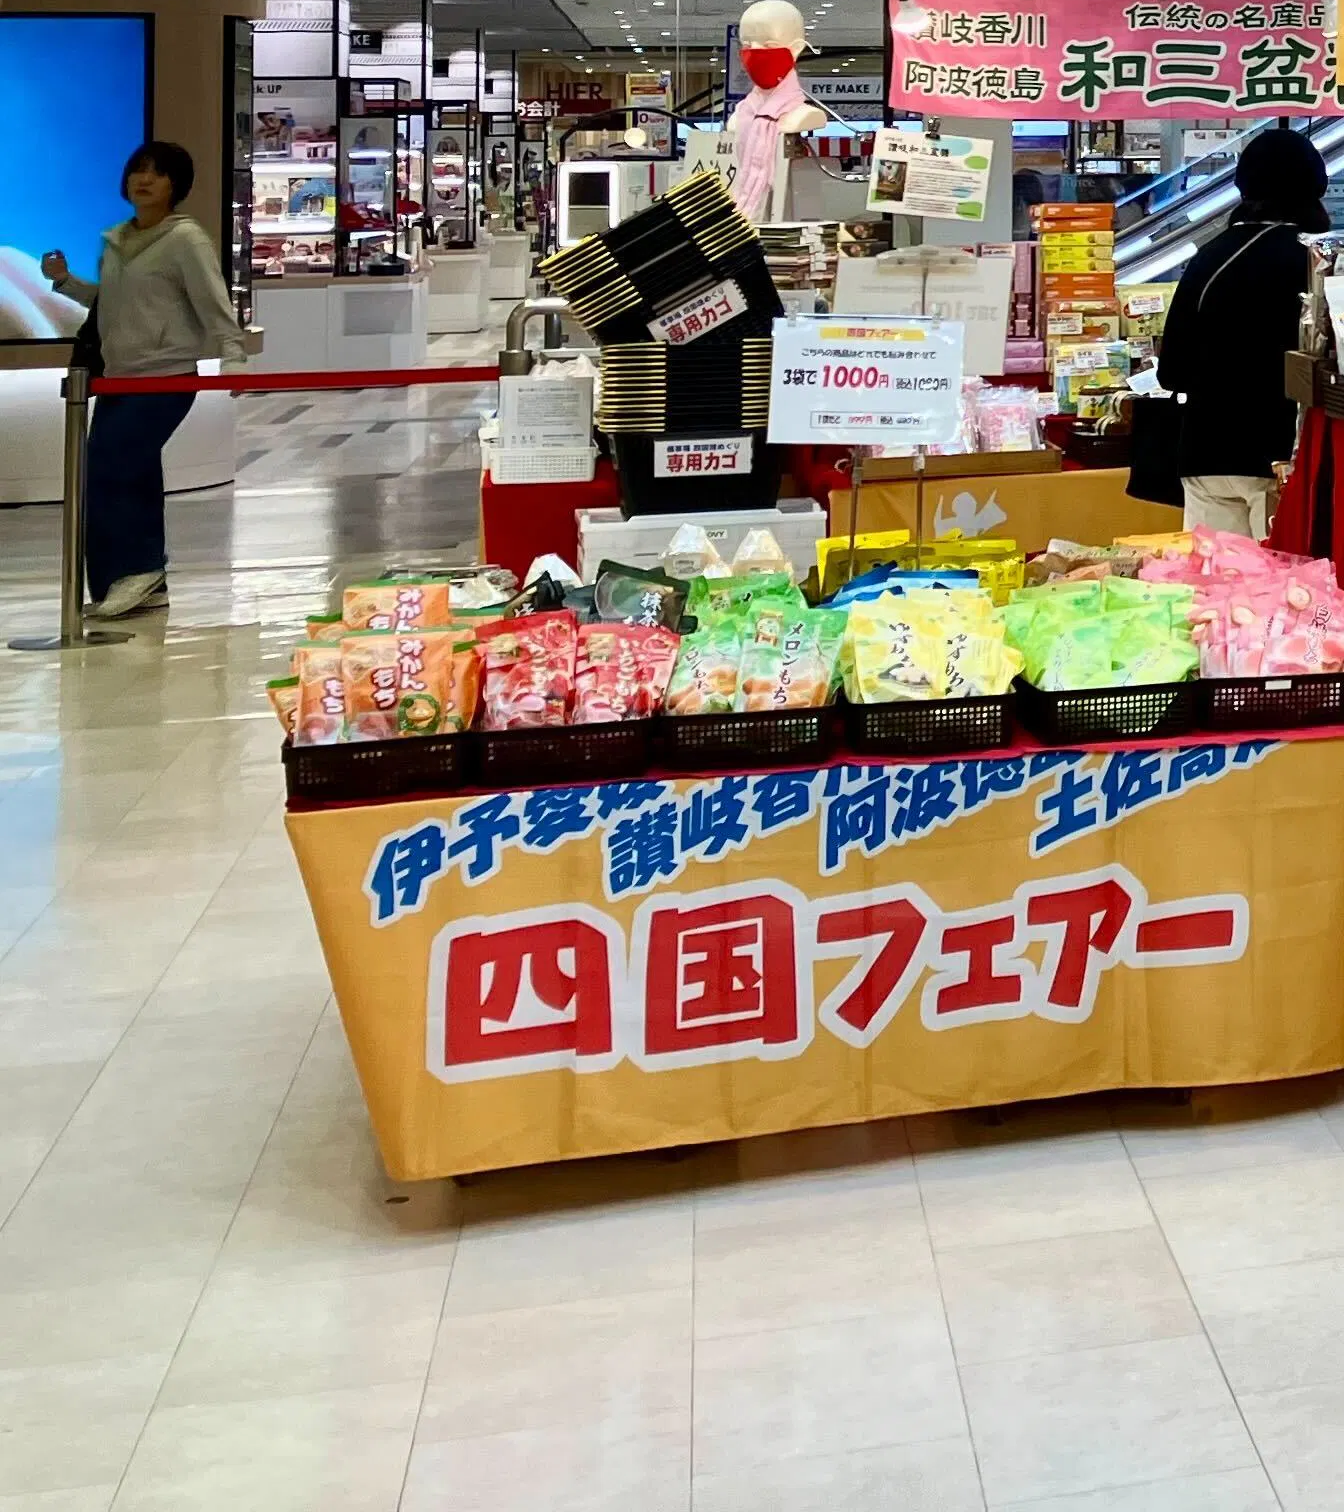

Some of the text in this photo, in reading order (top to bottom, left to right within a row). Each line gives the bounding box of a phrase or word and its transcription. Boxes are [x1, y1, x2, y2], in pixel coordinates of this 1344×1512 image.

[811, 84, 832, 94] EYE
[841, 83, 870, 94] MAKE
[904, 61, 1046, 101] 阿波徳島
[667, 300, 733, 345] 専用カゴ
[782, 368, 818, 386] 3袋で
[821, 364, 890, 389] 1000円
[666, 451, 738, 473] 専用カゴ
[372, 638, 425, 710] みかん もち
[772, 621, 803, 705] メロンもち
[320, 678, 345, 714] もち
[825, 751, 1087, 871] 阿波徳
[1034, 739, 1280, 851] 土佐高
[445, 886, 1236, 1066] 四国フェアー
